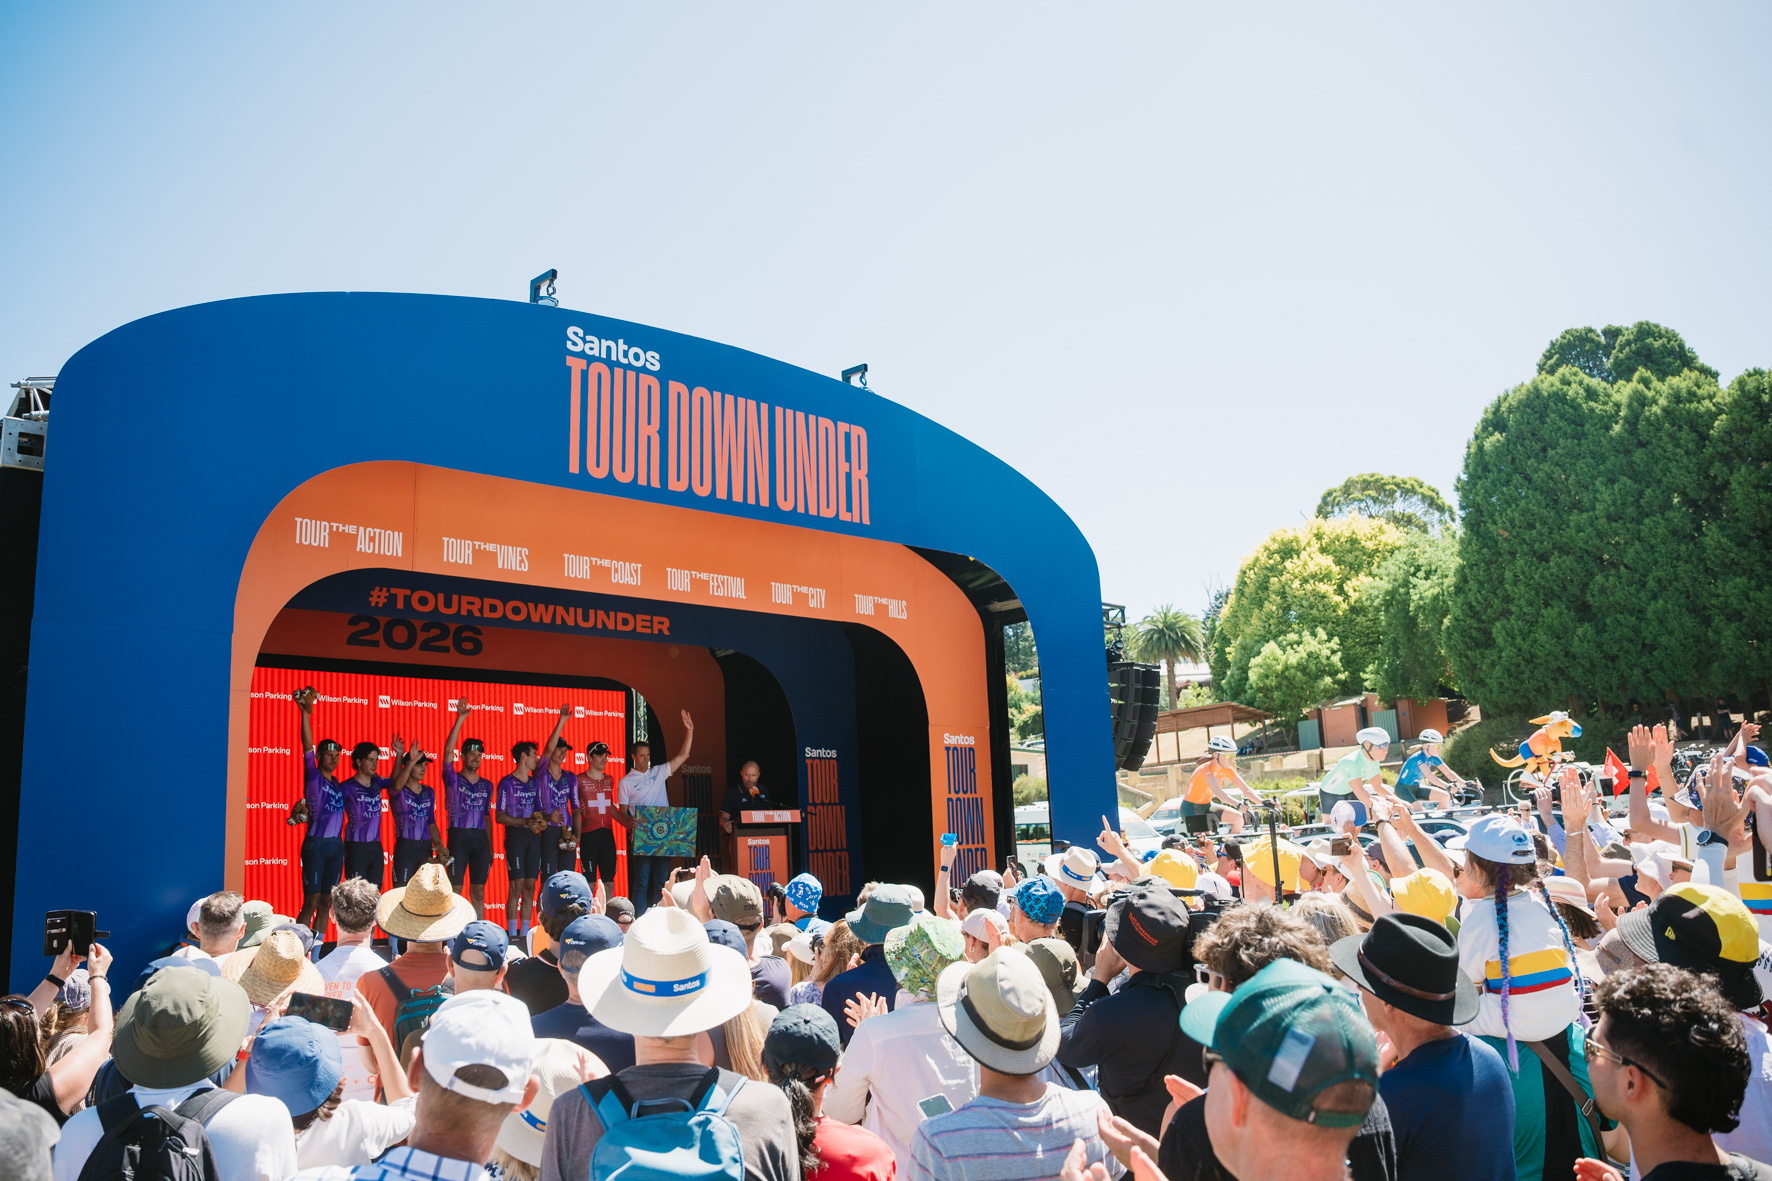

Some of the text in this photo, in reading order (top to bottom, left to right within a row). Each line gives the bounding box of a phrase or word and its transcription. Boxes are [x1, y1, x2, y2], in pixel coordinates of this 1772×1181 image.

[566, 325, 661, 371] Santos
[565, 355, 871, 525] TOUR DOWN UNDER
[295, 517, 403, 557] TOUR THE ACTION
[442, 537, 529, 572] TOUR THE VINES
[563, 553, 642, 586] TOUR THE COAST
[666, 567, 747, 599] TOUR THE FESTIVAL
[771, 582, 826, 609] TOUR THE CITY
[368, 586, 671, 635] #TOURDOWNUNDER
[854, 594, 907, 620] TOUR THE HILLS
[346, 614, 484, 656] 2026
[264, 691, 293, 701] Parking
[319, 694, 369, 705] Wilson Parking
[391, 699, 438, 709] Wilson Parking
[466, 702, 504, 712] ilson Parking
[525, 706, 544, 714] Wilson
[604, 710, 625, 718] Parking
[944, 733, 975, 745] Santos
[263, 746, 291, 755] Parking
[805, 747, 837, 758] Santos
[481, 753, 504, 761] Parking
[606, 756, 625, 764] arking
[681, 764, 712, 774] Santos
[945, 746, 977, 795] TOUR
[805, 759, 839, 804] TOUR
[322, 784, 343, 799] Jayc
[459, 786, 487, 798] Jayco
[357, 794, 382, 804] Jayc
[260, 801, 289, 810] Parking
[751, 811, 765, 822] TOUR
[773, 811, 792, 822] ACTION
[947, 797, 985, 845] DOWN
[807, 805, 847, 850] DOWN
[260, 857, 288, 866] Parking
[748, 846, 770, 871] TOUR
[809, 851, 850, 896] UNDER
[324, 981, 352, 991] VEN TO
[673, 979, 700, 992] Santos
